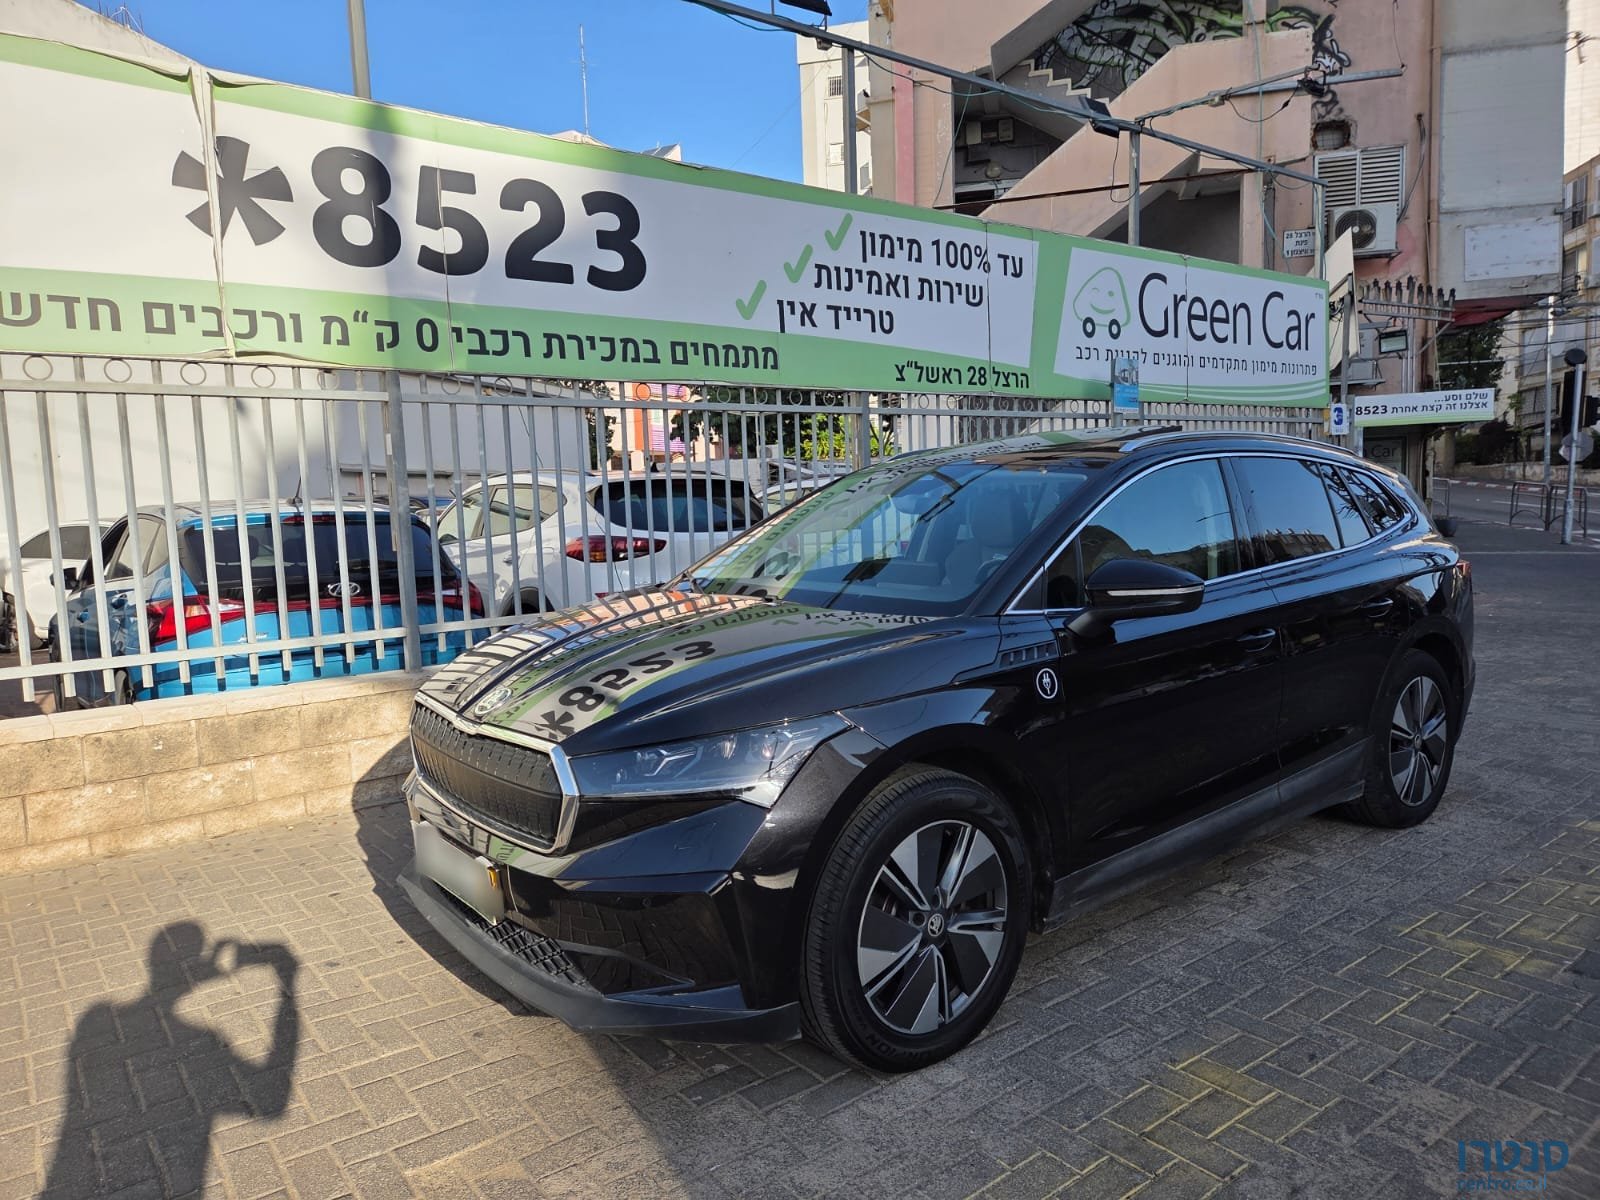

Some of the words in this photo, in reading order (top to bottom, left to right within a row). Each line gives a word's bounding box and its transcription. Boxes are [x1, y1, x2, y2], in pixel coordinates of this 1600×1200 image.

[859, 230, 923, 264] מימון
[931, 239, 991, 274] 100%
[997, 253, 1023, 278] עד
[813, 263, 910, 299] ואמינות
[917, 276, 984, 307] שירות
[142, 300, 304, 344] ורכבים
[776, 298, 818, 334] אין
[826, 304, 894, 335] טרייד
[1137, 272, 1252, 346] Green
[1261, 291, 1316, 351] Car
[415, 317, 440, 353] 0
[450, 326, 532, 359] רכבי
[542, 332, 661, 365] במכירת
[669, 340, 779, 370] מתמחים
[1075, 346, 1100, 361] רכב
[1153, 351, 1194, 368] והוגנים
[1199, 355, 1248, 373] מתקדמים
[1251, 359, 1278, 375] מימון
[1280, 361, 1318, 376] פתרונות
[966, 366, 988, 386] 28
[991, 367, 1030, 389] הרצל
[1445, 402, 1457, 411] זה
[1460, 400, 1488, 411] אצלנו
[1465, 391, 1488, 401] שלם
[1355, 405, 1388, 416] 8523
[1390, 405, 1418, 415] אחרת
[1421, 403, 1443, 414] קצת
